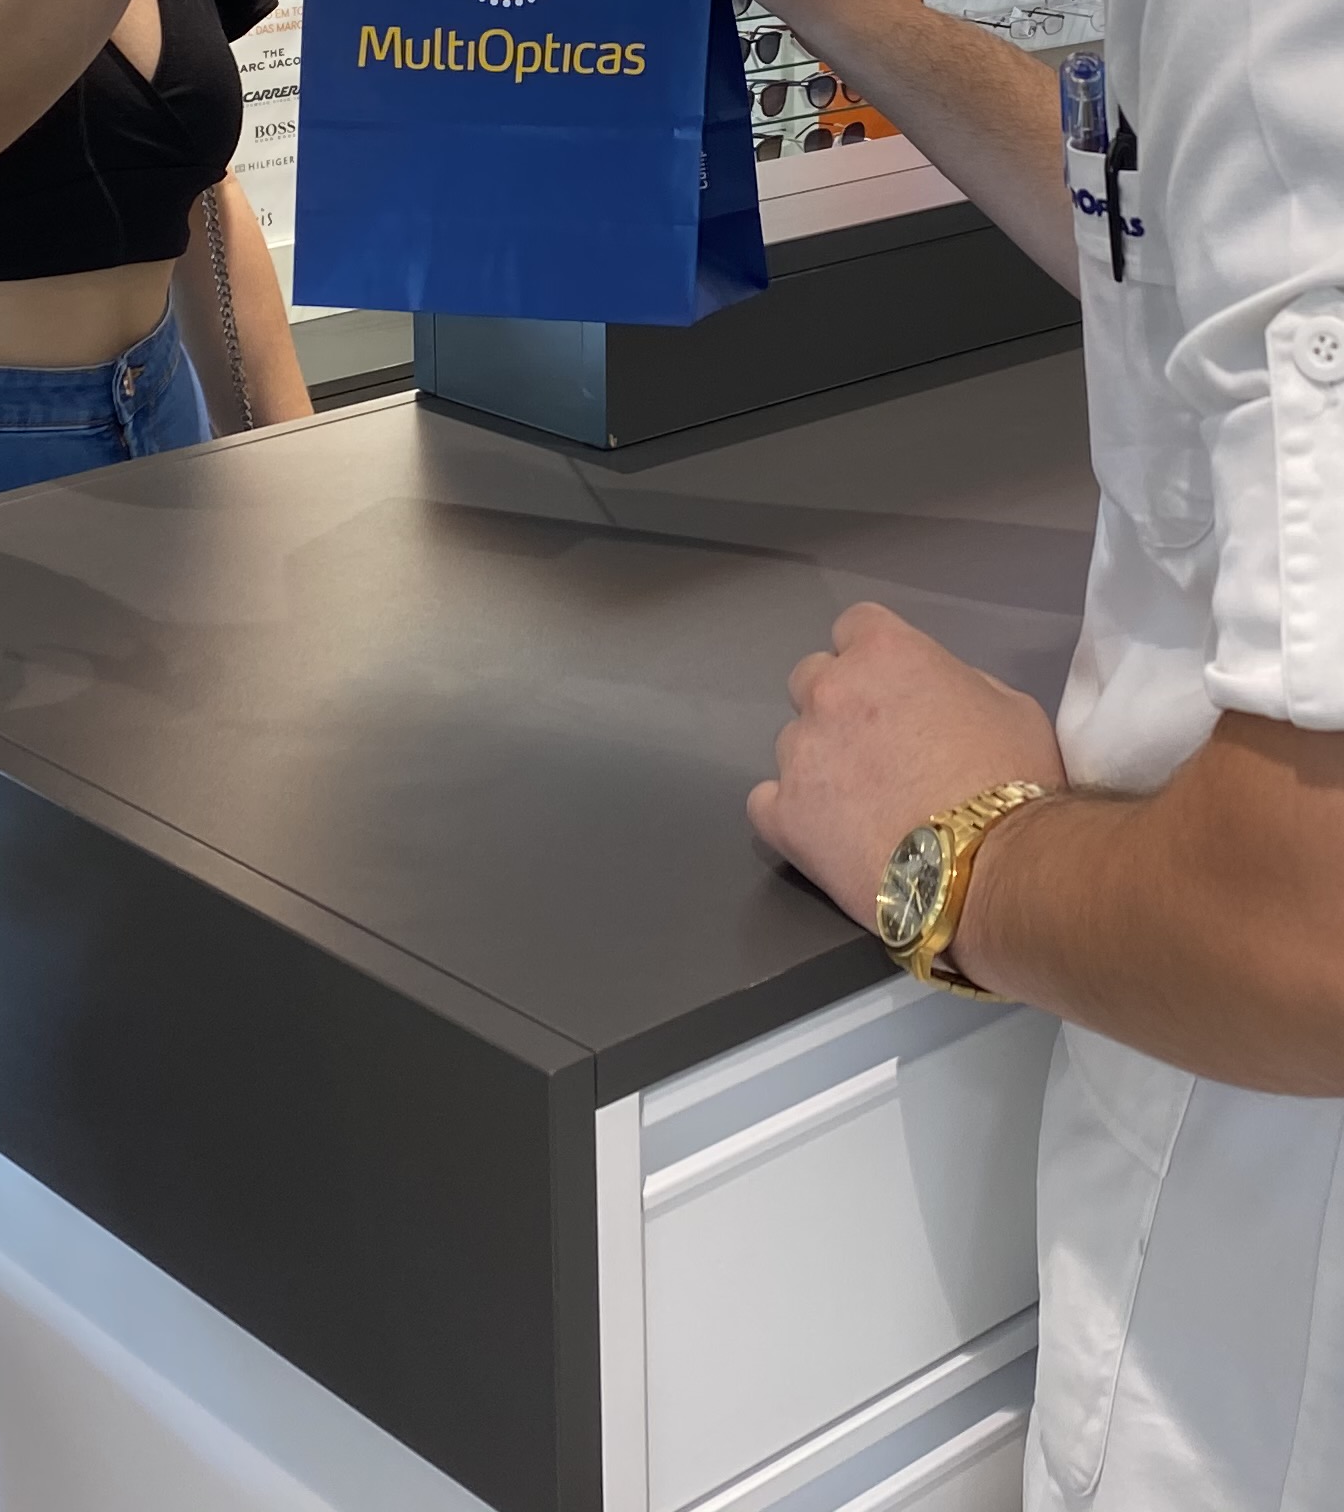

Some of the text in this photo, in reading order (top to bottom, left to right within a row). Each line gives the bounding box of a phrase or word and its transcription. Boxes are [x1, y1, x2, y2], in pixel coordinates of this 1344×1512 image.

[255, 23, 275, 36] DAS
[262, 47, 285, 59] THE
[357, 24, 646, 84] MultiOpticas
[239, 55, 302, 74] ARC JACO
[255, 120, 296, 139] BOSS
[247, 155, 295, 171] HILFIGER
